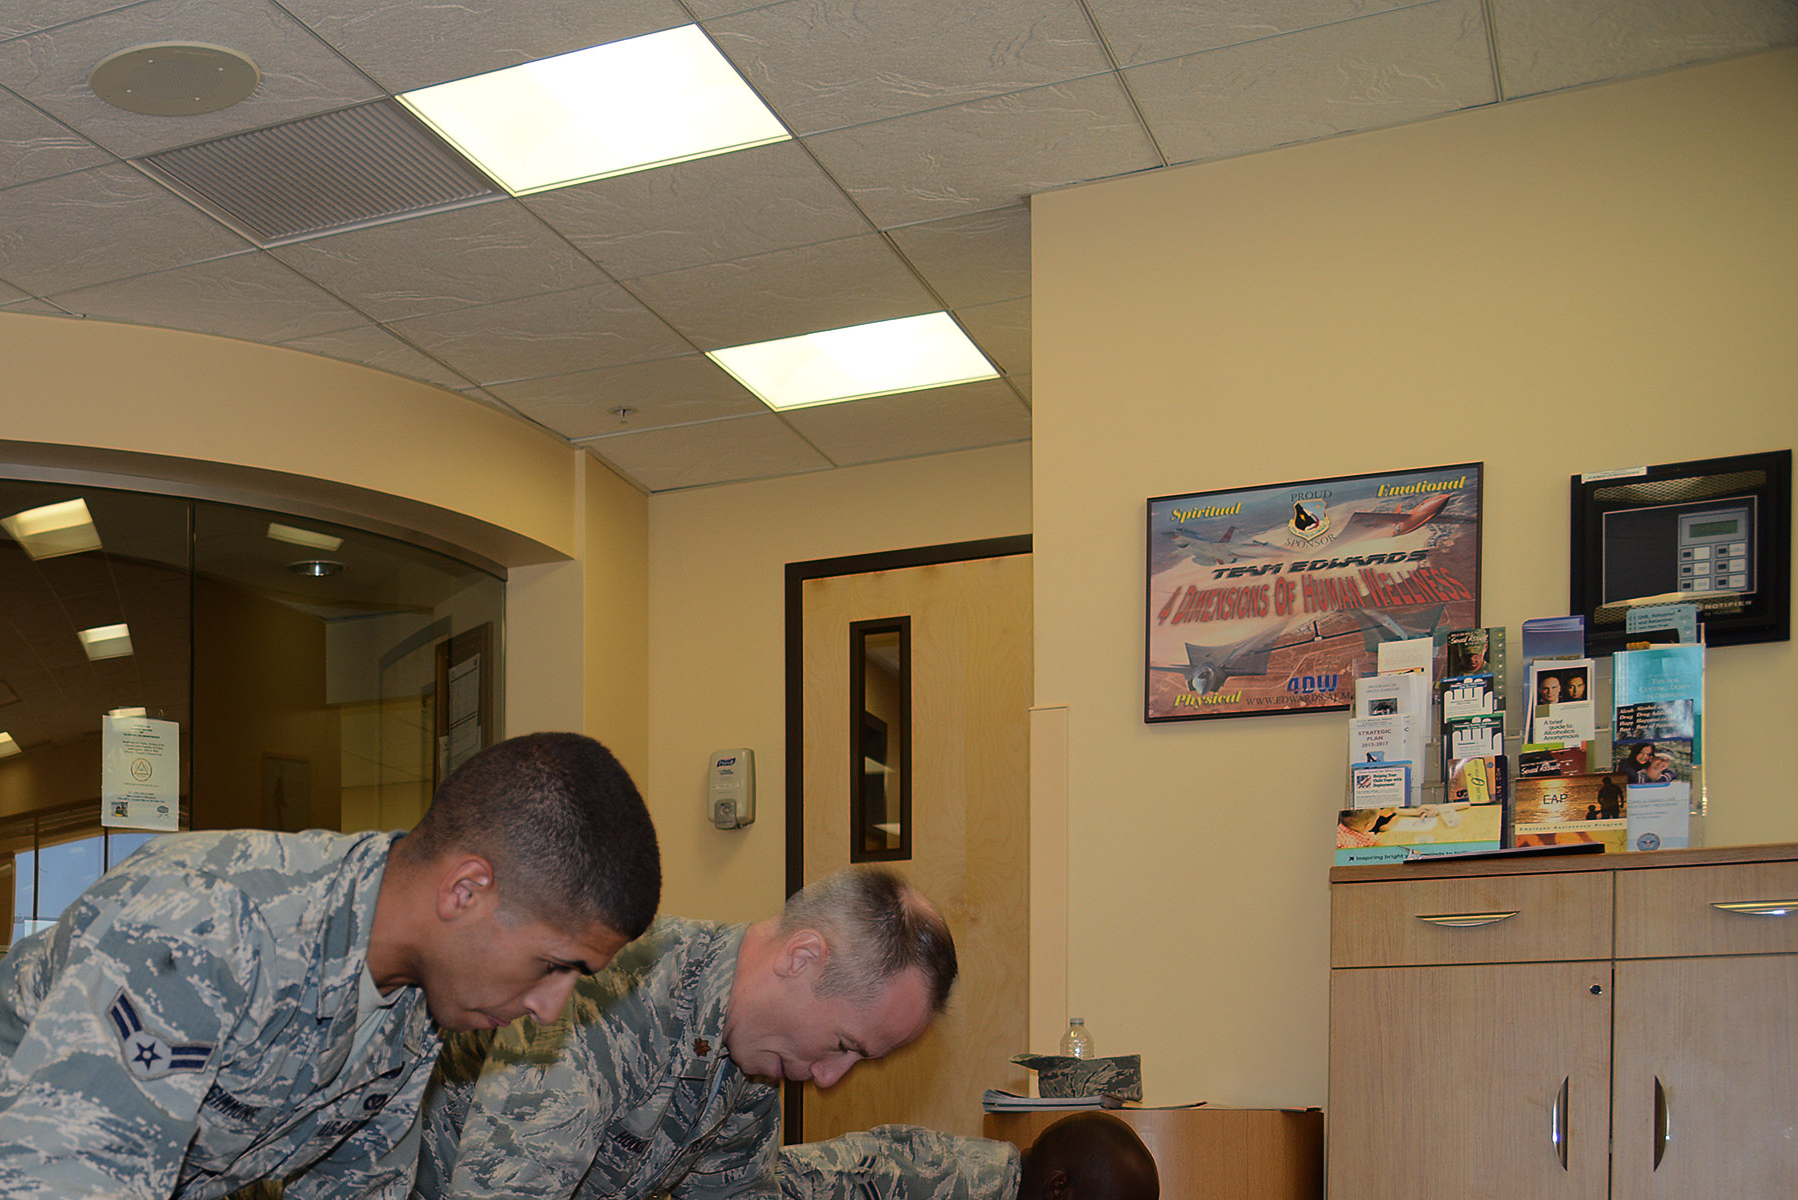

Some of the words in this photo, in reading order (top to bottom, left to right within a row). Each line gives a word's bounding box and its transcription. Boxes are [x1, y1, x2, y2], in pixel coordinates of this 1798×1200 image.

[1377, 476, 1467, 498] Emotional
[1290, 489, 1333, 502] PROUD
[1170, 502, 1242, 524] Spiritual
[1285, 533, 1337, 548] SPONSOR
[1211, 562, 1285, 580] TEAM
[1287, 549, 1429, 574] EDWARDS
[1286, 674, 1339, 695] 4DW
[1174, 690, 1243, 709] Physical
[1358, 728, 1392, 736] STRATEGIC
[1543, 728, 1576, 736] Alcoholics
[1543, 733, 1580, 741] Anonymous
[1543, 793, 1568, 805] EAP
[1356, 854, 1384, 862] Inspiring
[1384, 852, 1404, 861] bright
